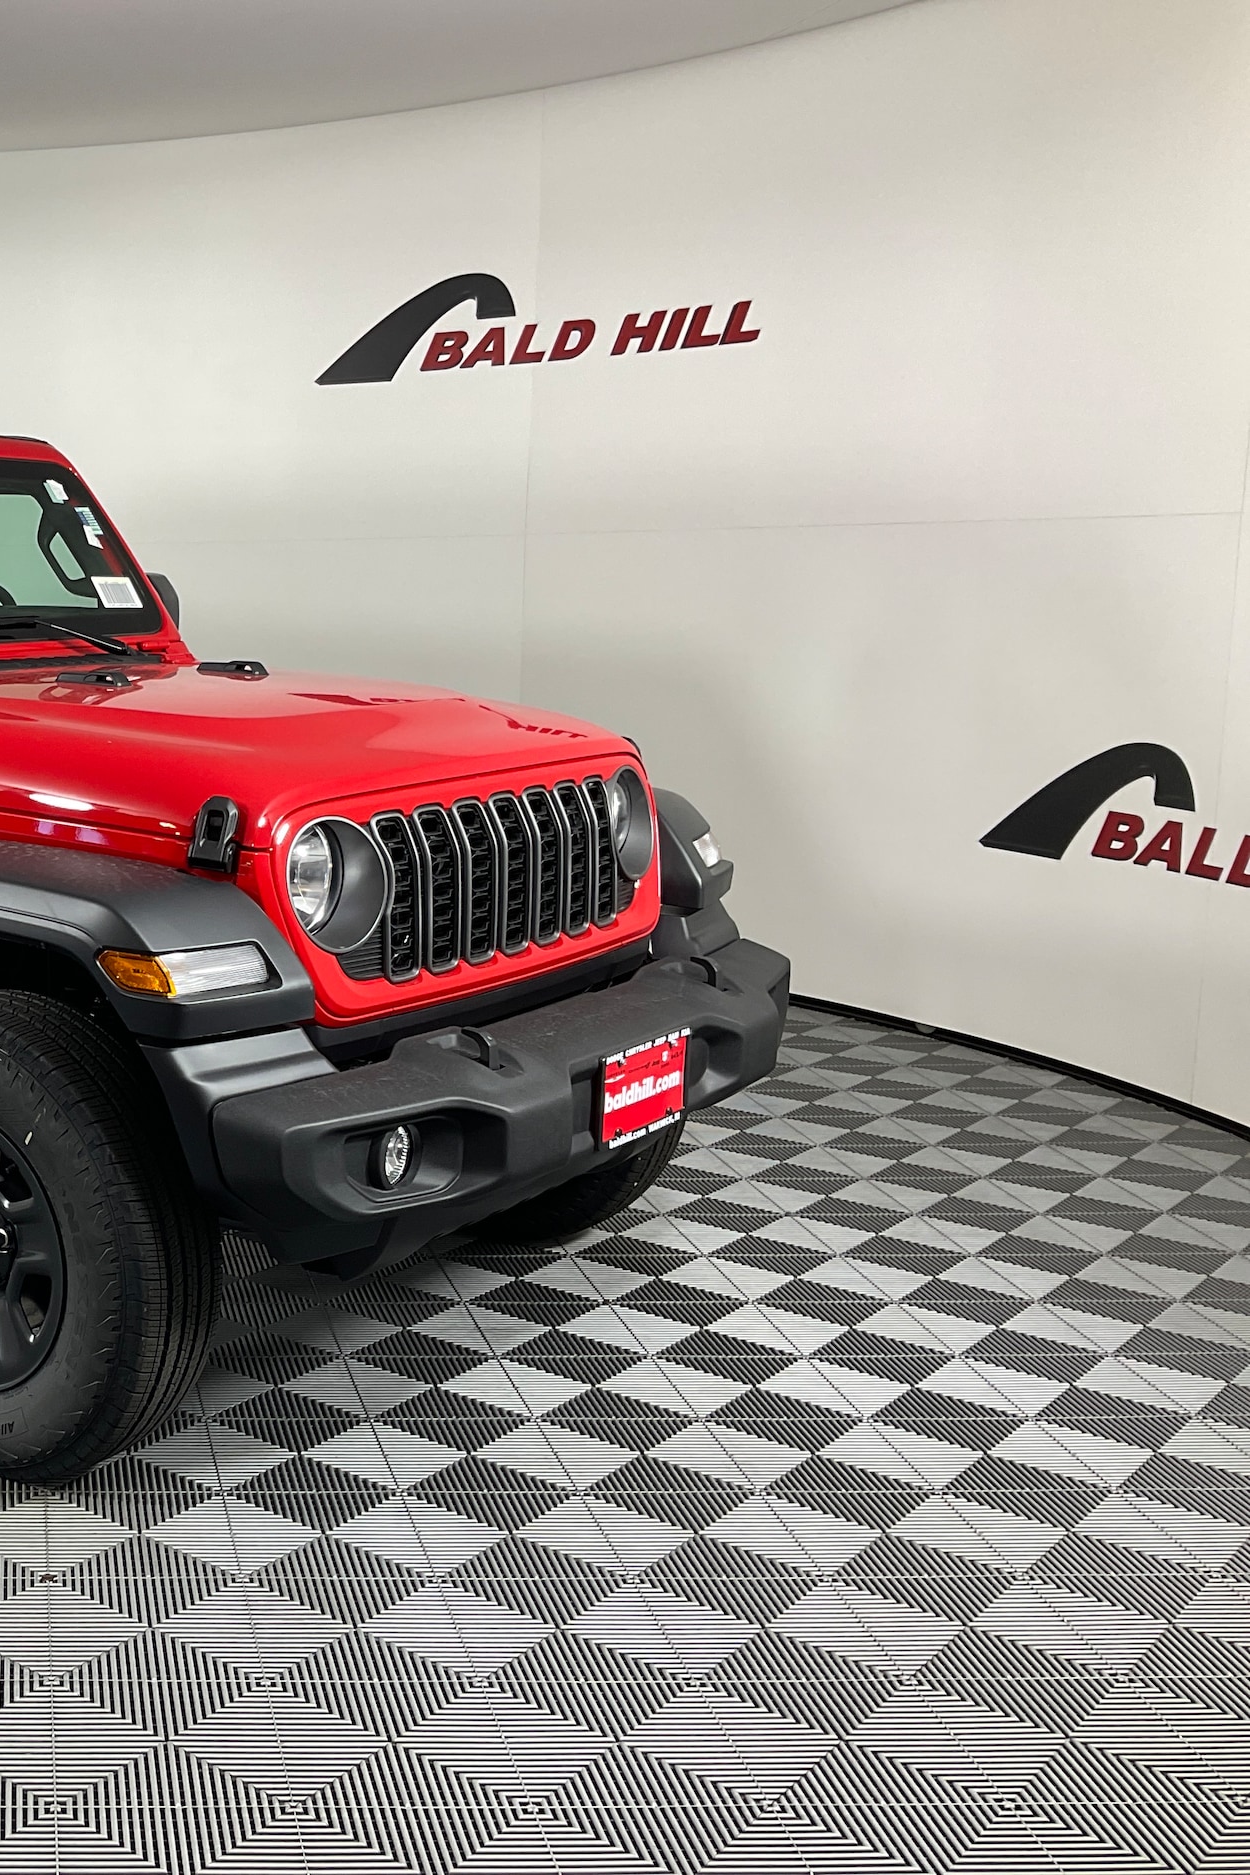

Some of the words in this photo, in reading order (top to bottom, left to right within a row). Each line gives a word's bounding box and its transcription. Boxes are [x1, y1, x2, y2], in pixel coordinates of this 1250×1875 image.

[420, 318, 596, 372] BALD
[610, 299, 762, 356] HILL
[653, 1036, 666, 1047] JEEP
[604, 1070, 681, 1115] baldhill.com
[608, 1128, 647, 1150] baldhill.com
